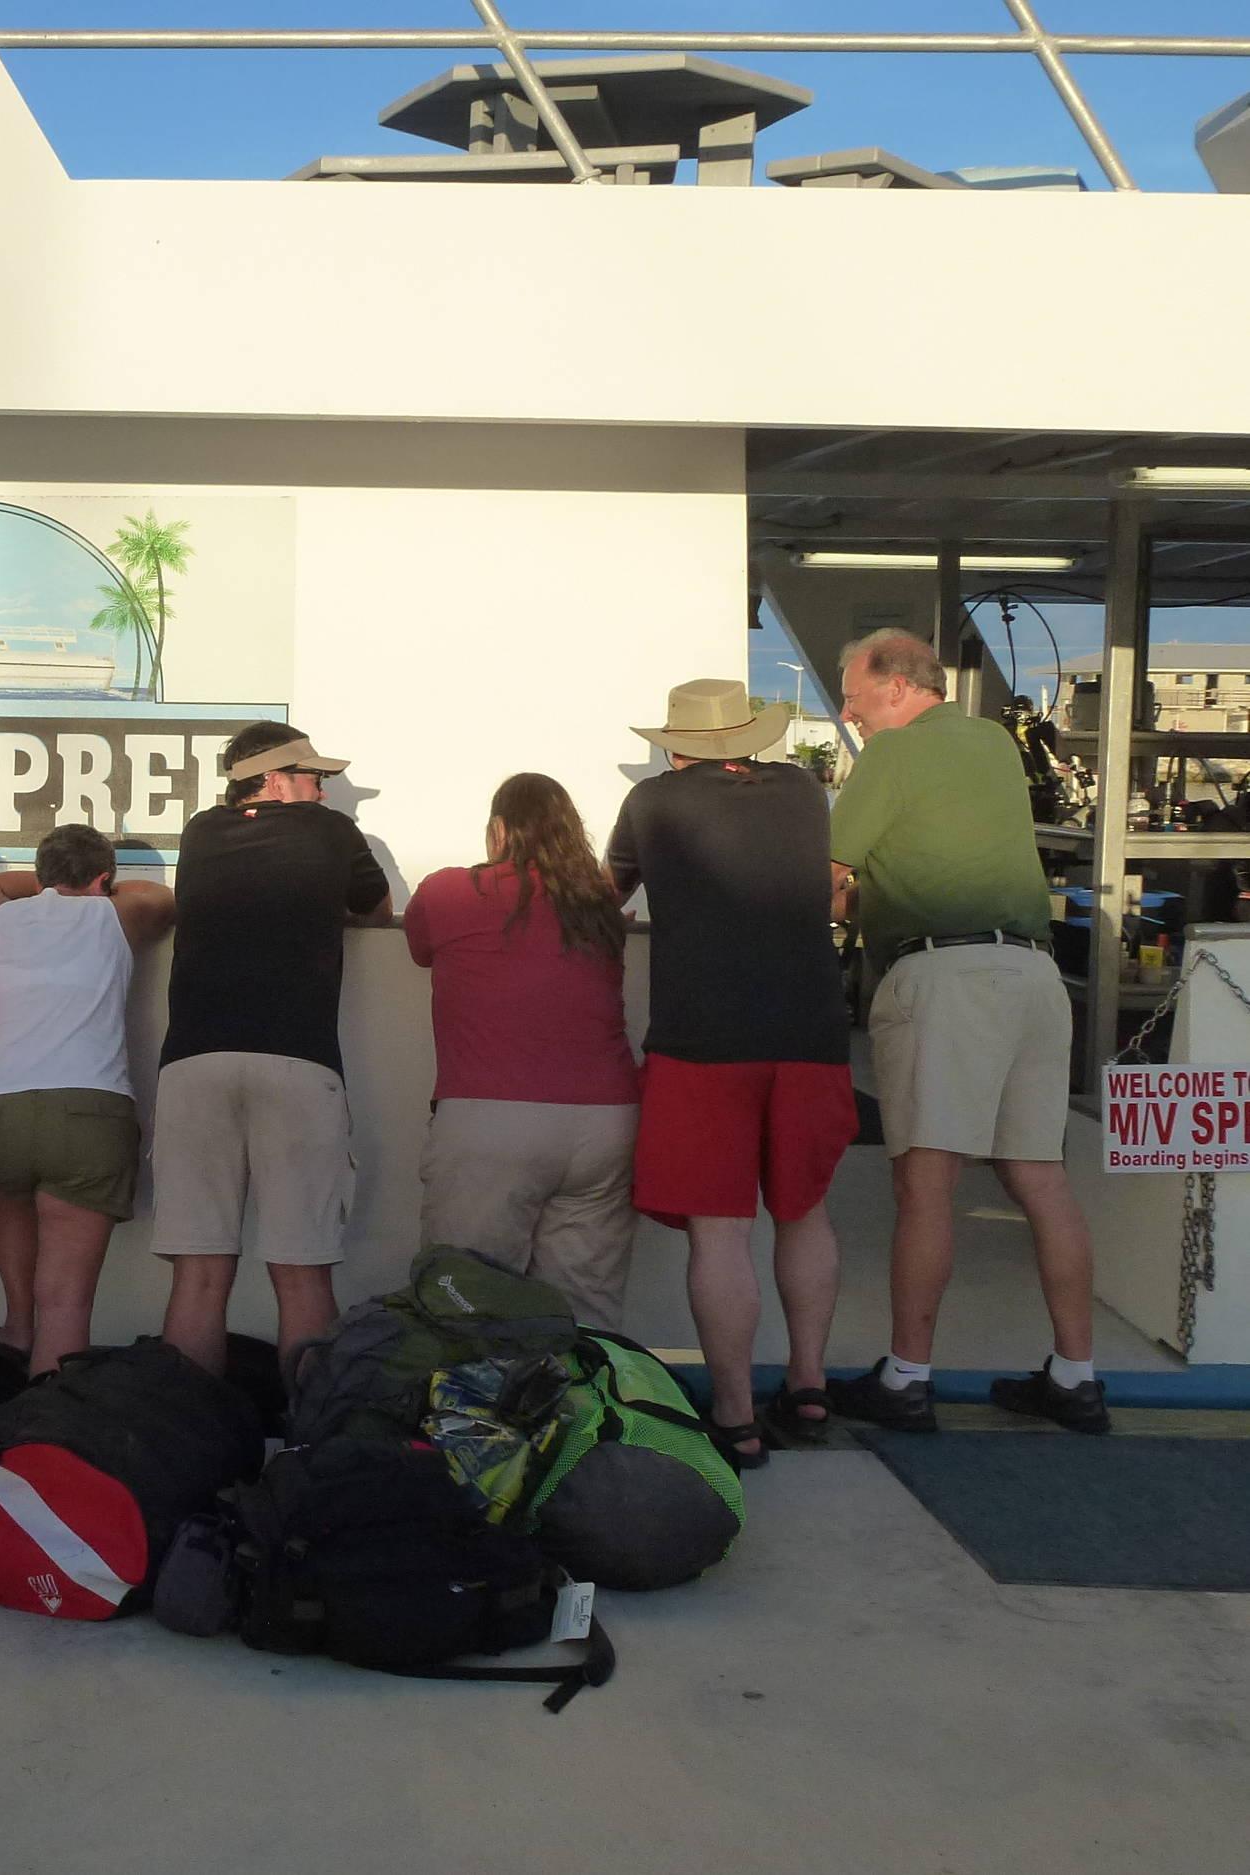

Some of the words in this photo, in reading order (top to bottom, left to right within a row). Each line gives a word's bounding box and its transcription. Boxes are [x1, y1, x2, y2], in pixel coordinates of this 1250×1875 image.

[1108, 1072, 1225, 1098] WELCOME
[1233, 1071, 1250, 1097] T
[1109, 1102, 1178, 1146] M/V
[1191, 1101, 1250, 1145] SP
[1109, 1150, 1187, 1170] Boarding
[1192, 1149, 1250, 1169] begins
